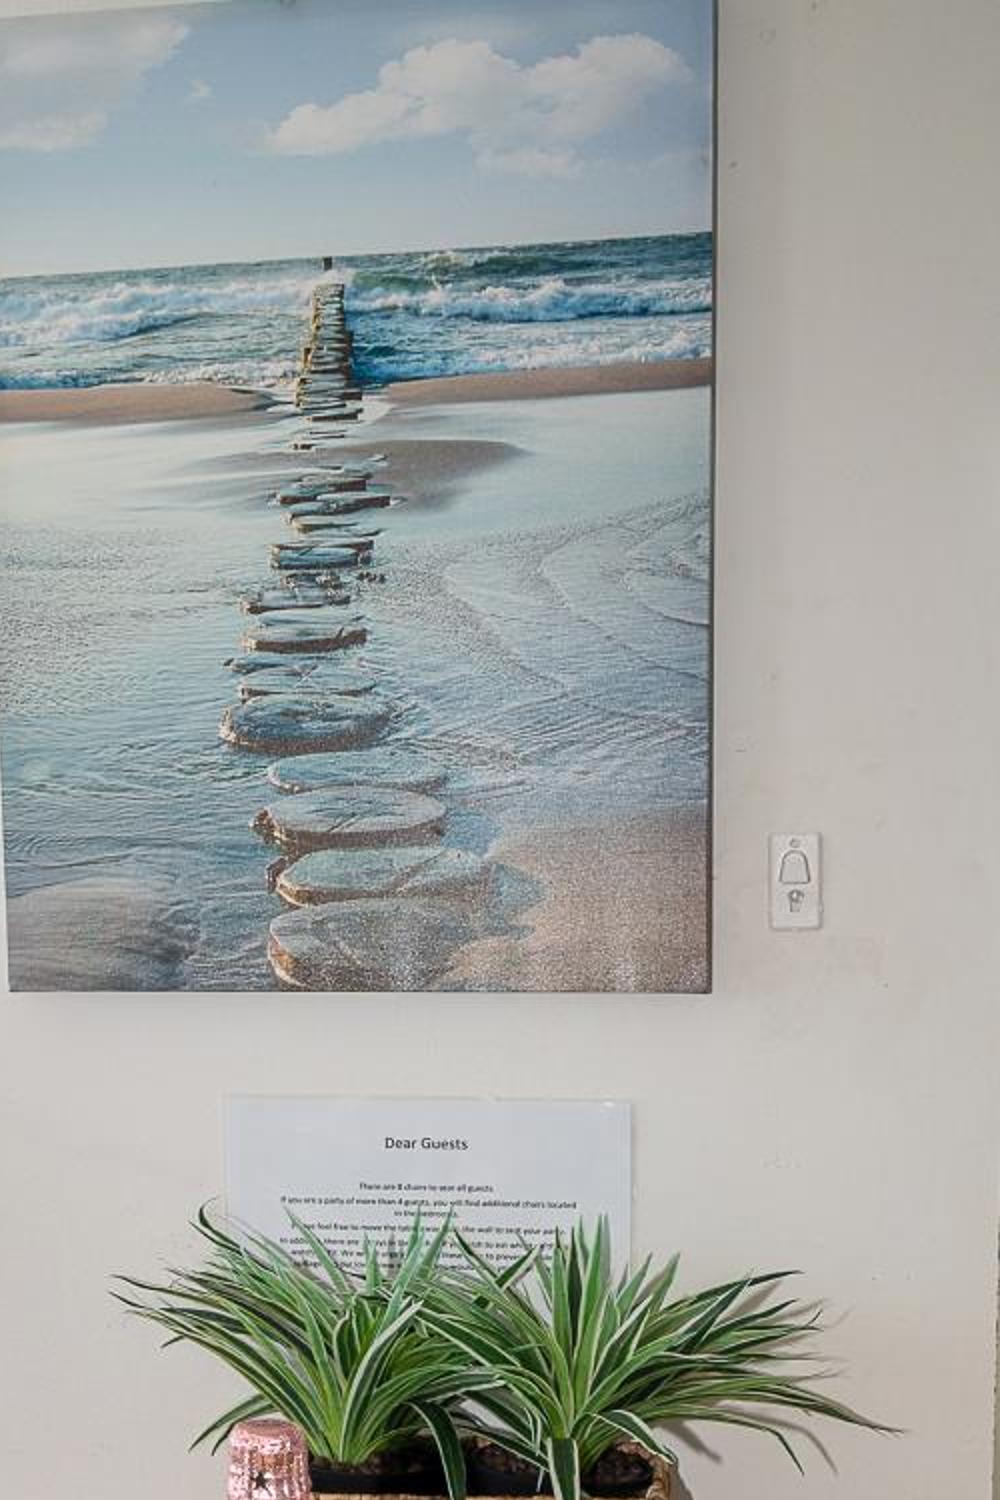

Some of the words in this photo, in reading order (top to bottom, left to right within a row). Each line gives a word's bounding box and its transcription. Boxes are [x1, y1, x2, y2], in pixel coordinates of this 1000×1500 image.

[384, 1137, 417, 1149] Dear
[420, 1137, 469, 1150] Guests
[323, 1197, 345, 1205] party
[345, 1196, 355, 1204] of
[377, 1197, 397, 1205] than
[464, 1199, 481, 1207] find
[481, 1200, 521, 1208] additional
[522, 1201, 545, 1209] chairs
[547, 1201, 577, 1209] located
